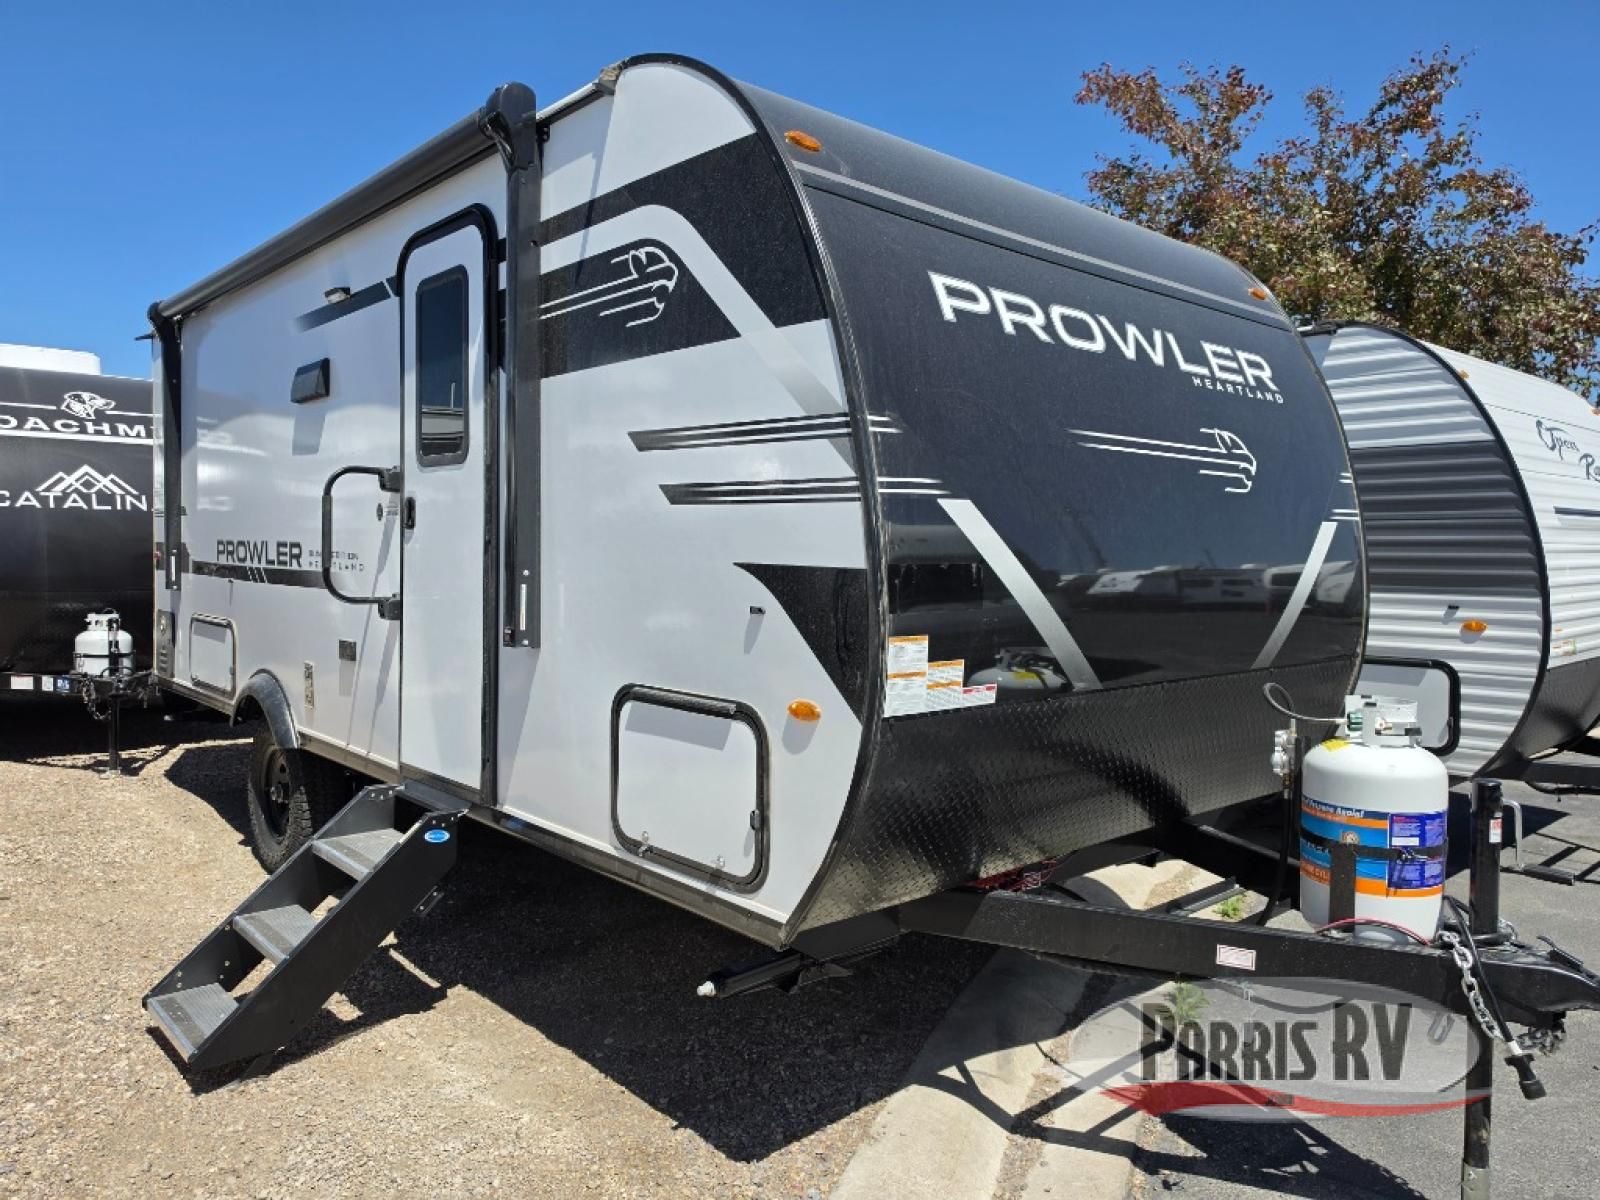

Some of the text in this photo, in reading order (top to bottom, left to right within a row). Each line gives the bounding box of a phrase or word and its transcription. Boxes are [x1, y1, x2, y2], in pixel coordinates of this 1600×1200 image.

[927, 271, 1280, 391] PROWLER
[1191, 376, 1284, 404] HEARTLAND
[0, 415, 153, 437] OACHM
[0, 489, 153, 512] CATALIN
[216, 539, 302, 568] PROWLER
